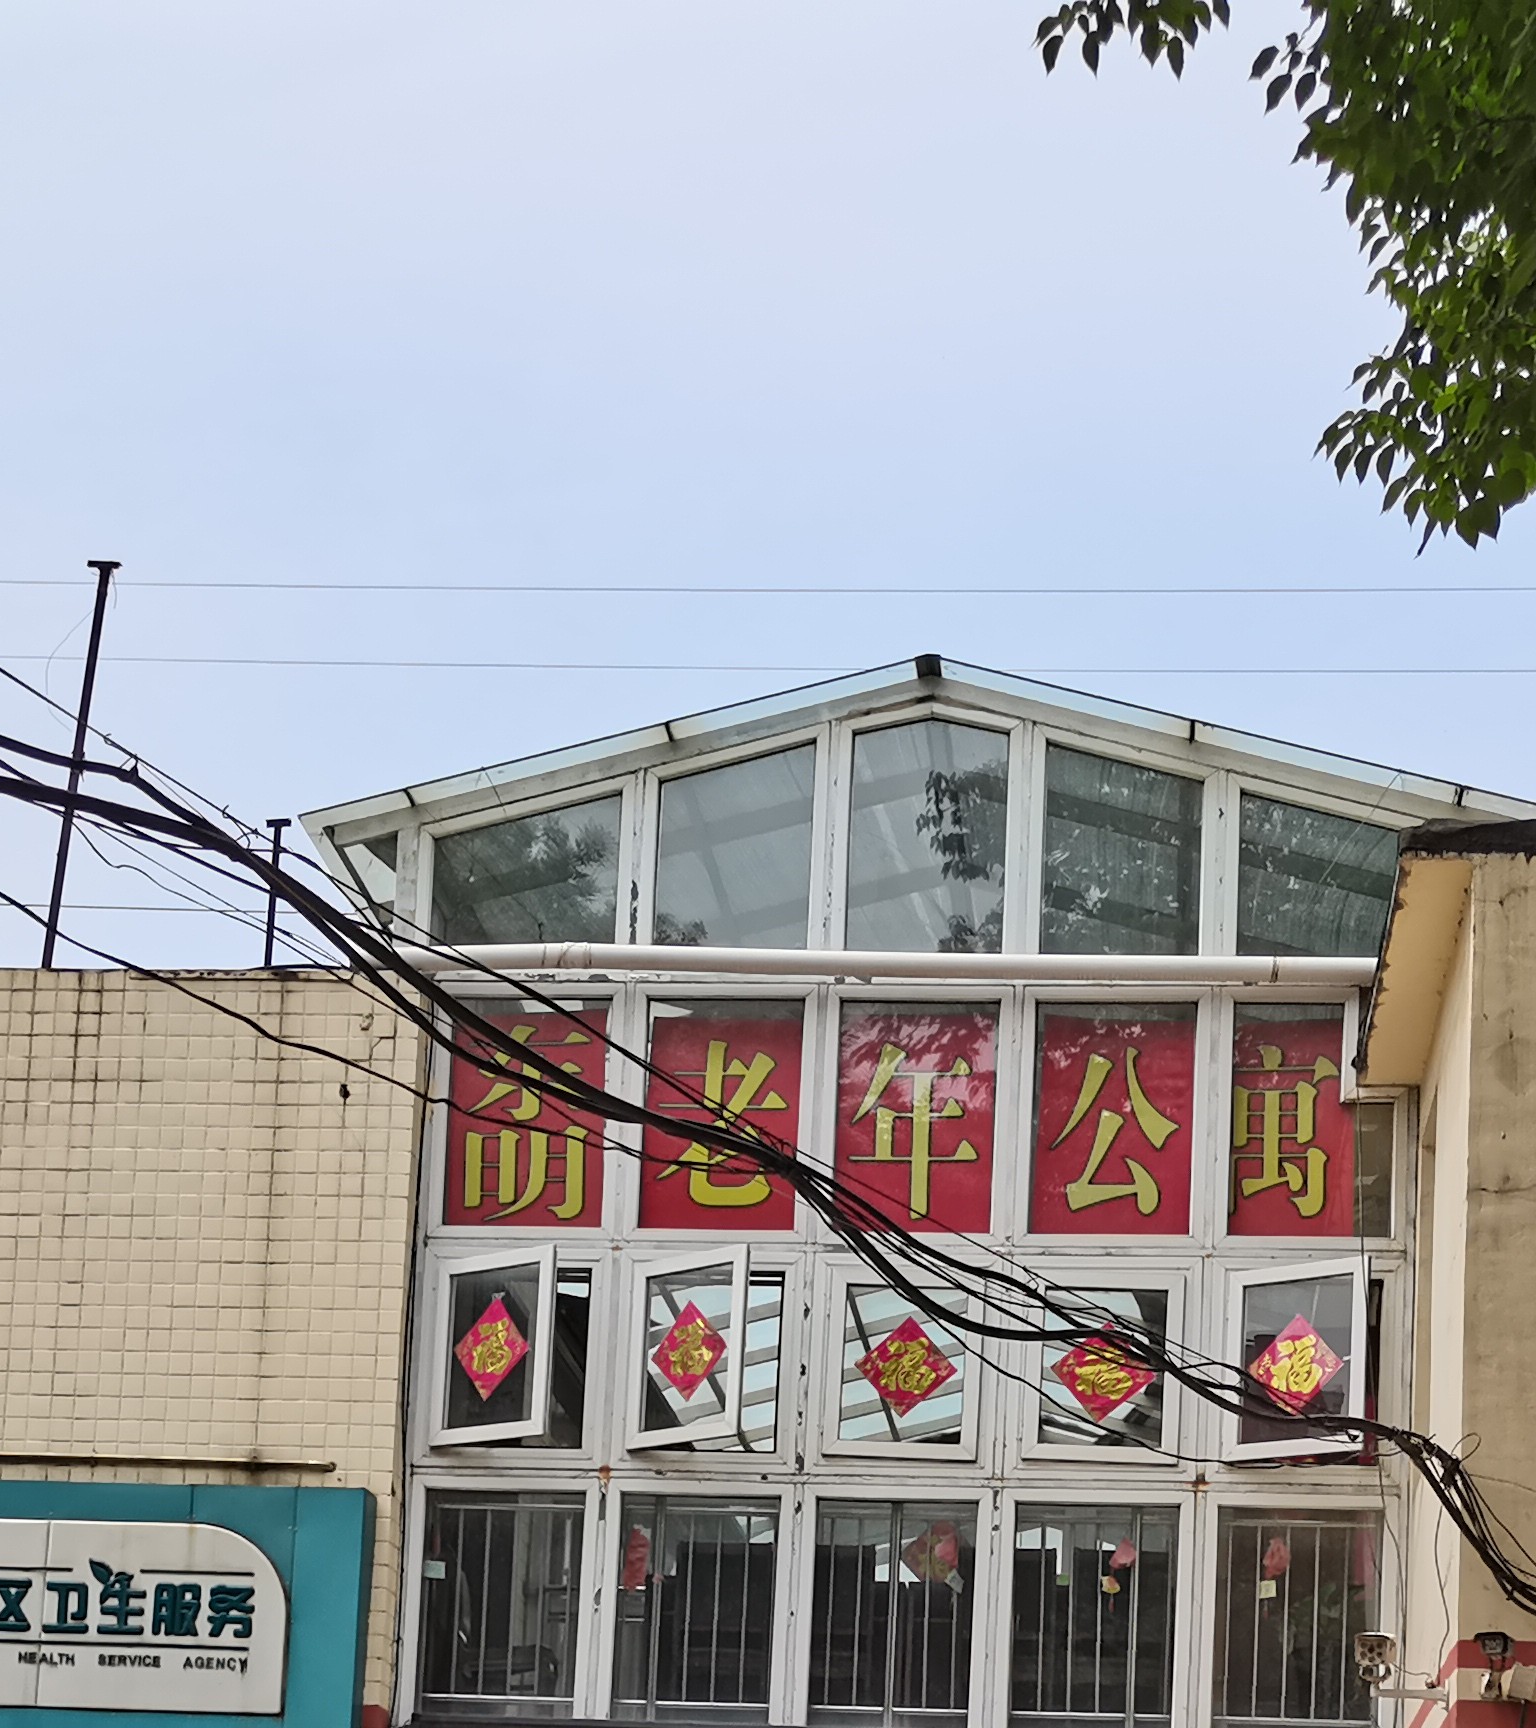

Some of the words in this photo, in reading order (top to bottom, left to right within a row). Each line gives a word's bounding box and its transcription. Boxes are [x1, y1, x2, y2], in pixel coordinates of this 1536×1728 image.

[18, 1650, 76, 1667] HEALTH
[97, 1653, 161, 1668] SERVICE
[183, 1655, 249, 1673] AGENCY
